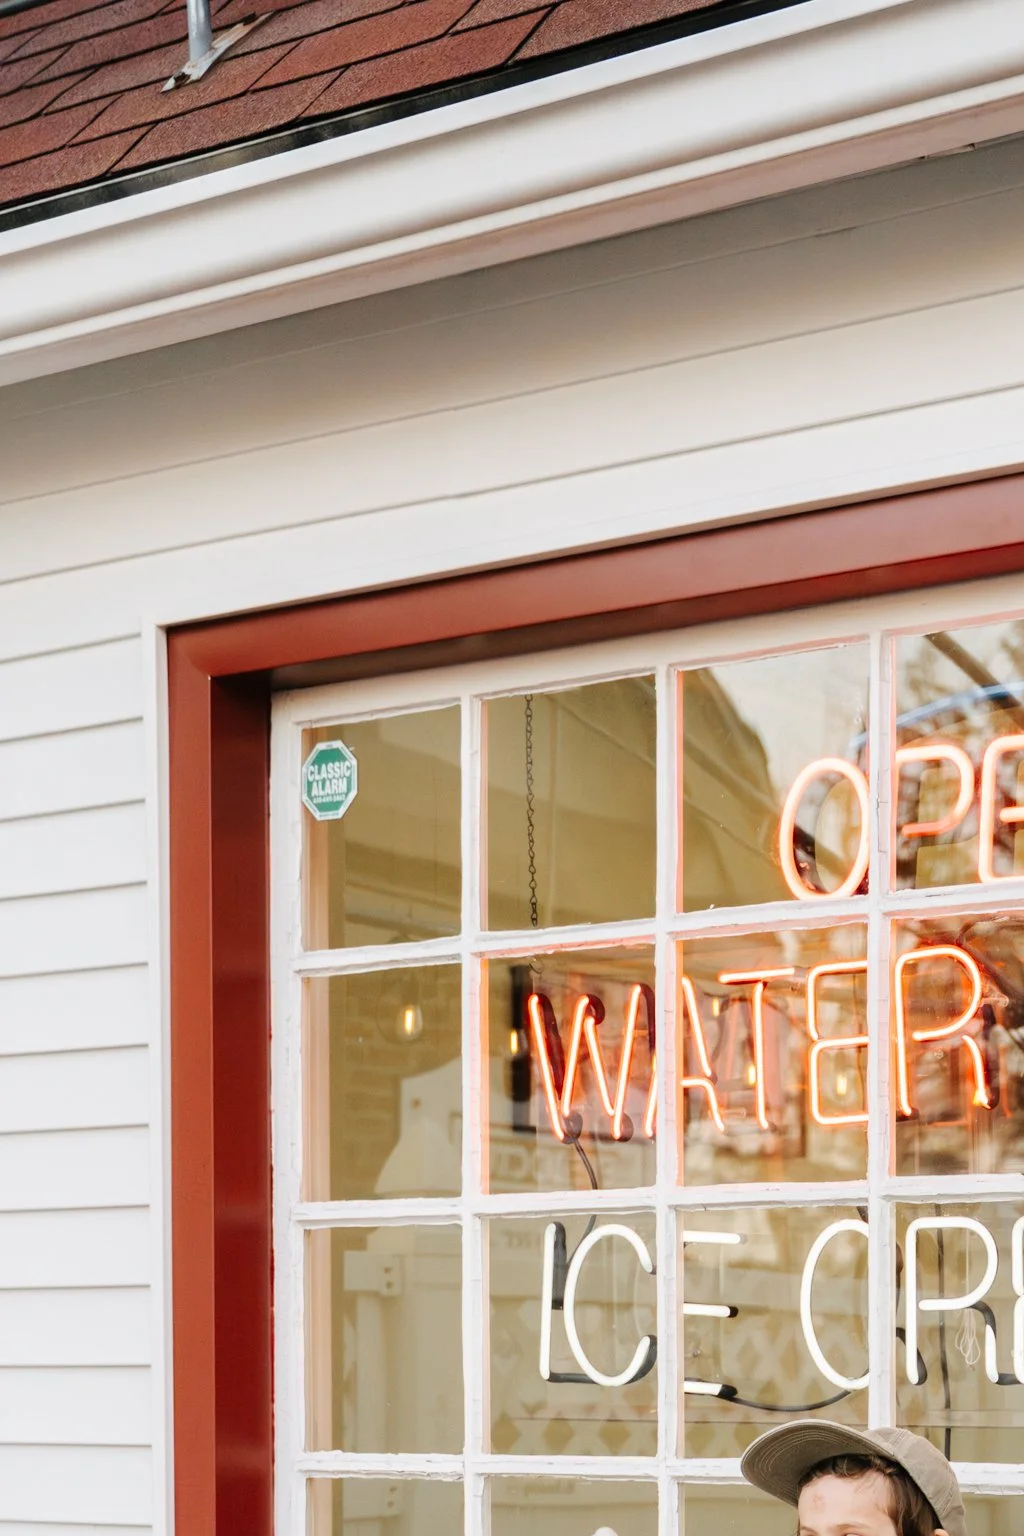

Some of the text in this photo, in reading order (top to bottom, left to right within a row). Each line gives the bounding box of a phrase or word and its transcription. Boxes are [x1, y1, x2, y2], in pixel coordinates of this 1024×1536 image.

[308, 760, 351, 782] CLASSIC
[311, 777, 347, 797] ALARM
[527, 943, 992, 1142] WATER
[539, 1222, 745, 1397] ICE
